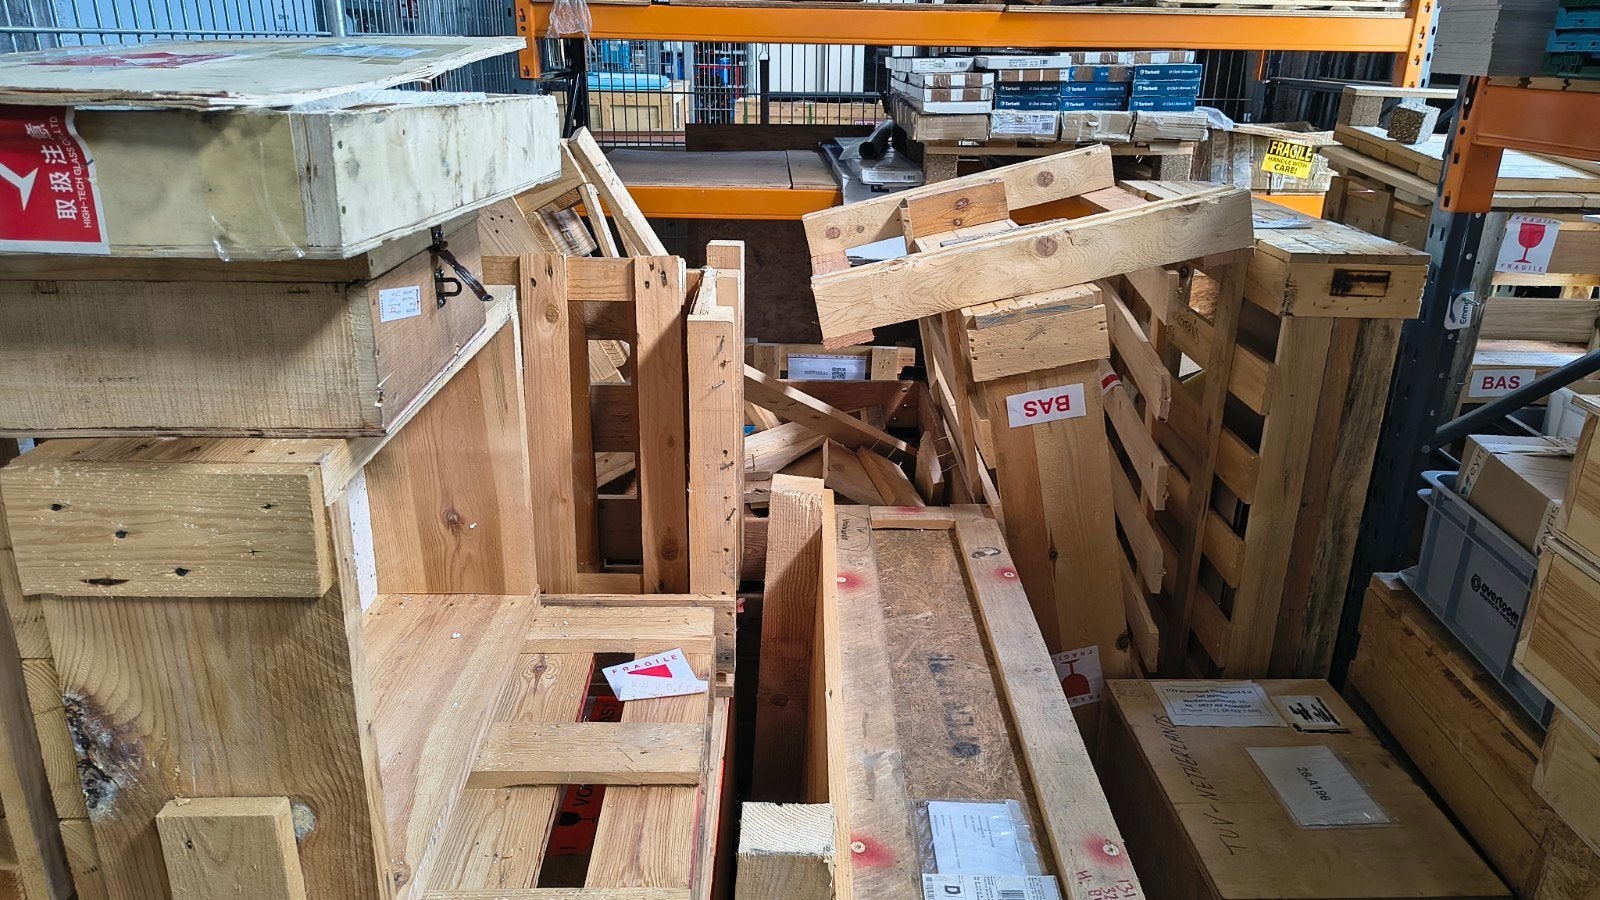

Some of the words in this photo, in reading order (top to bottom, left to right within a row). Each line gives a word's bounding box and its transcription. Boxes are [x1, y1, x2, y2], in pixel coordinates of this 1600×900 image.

[66, 147, 82, 176] GLASS
[1267, 156, 1292, 166] HANDLE
[1269, 141, 1313, 162] FRAGILE
[76, 177, 92, 228] HIGH-TECH
[1500, 263, 1543, 272] FRAGILE
[1482, 375, 1520, 389] BAS
[1023, 394, 1070, 417] BAS
[1481, 583, 1519, 624] overtoom
[612, 654, 677, 674] FRAGILE
[1154, 714, 1219, 801] NETHERLANDS
[1296, 767, 1331, 801] 26.A196
[1202, 812, 1247, 855] TUV
[944, 885, 961, 895] D
